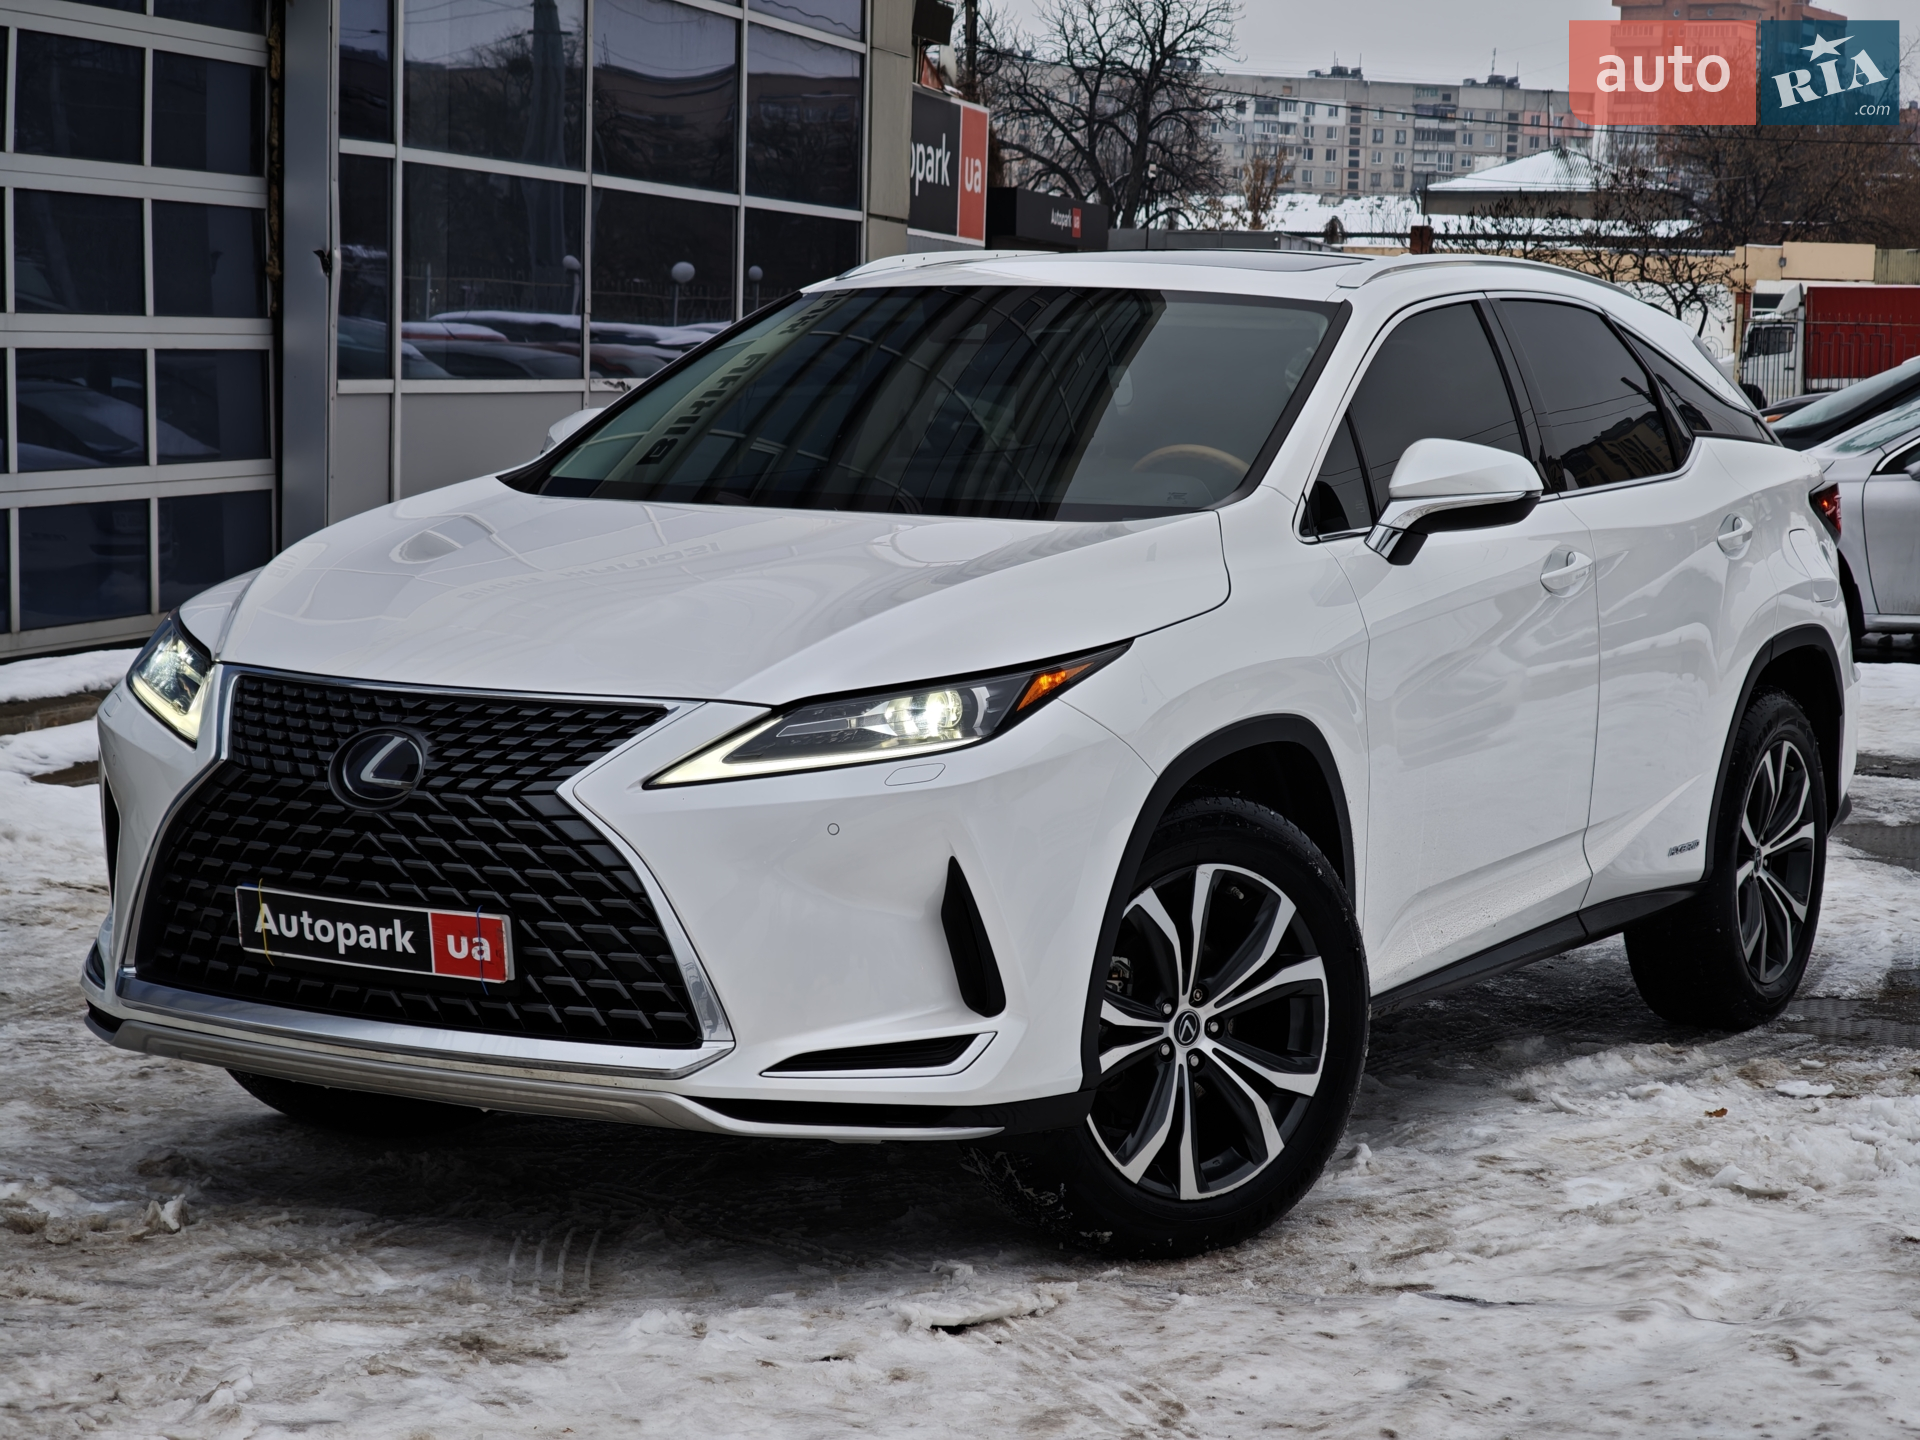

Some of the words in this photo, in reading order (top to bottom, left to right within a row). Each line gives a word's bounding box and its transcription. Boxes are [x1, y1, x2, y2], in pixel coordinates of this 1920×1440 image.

[965, 156, 982, 194] ua
[1051, 207, 1072, 231] Autopark
[1073, 215, 1080, 229] ua
[254, 903, 416, 954] Autopark
[446, 934, 491, 961] ua
